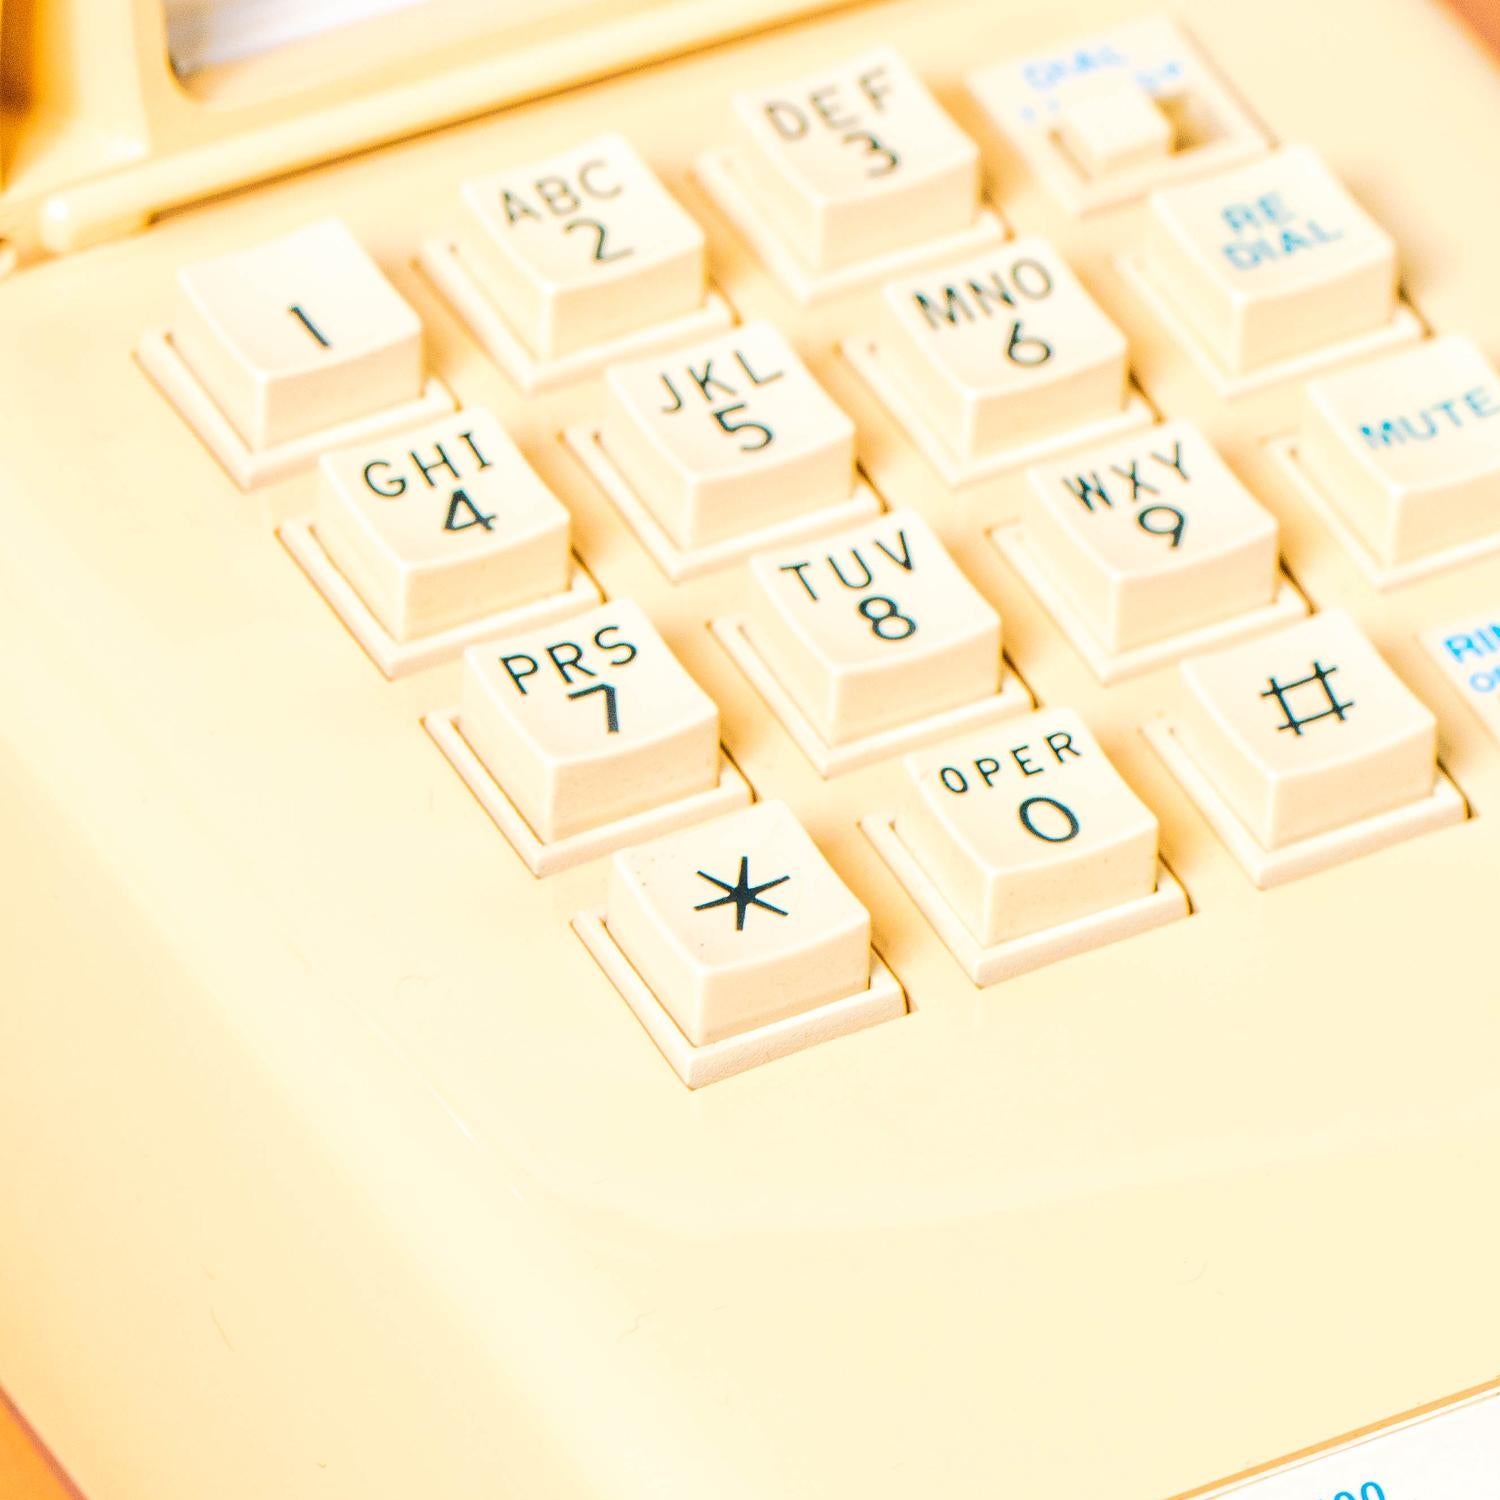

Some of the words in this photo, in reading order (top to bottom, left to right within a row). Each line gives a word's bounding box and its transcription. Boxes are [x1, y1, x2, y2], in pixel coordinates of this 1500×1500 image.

[762, 66, 893, 143] DEF
[842, 130, 903, 179] 3
[499, 159, 625, 227] ABC
[1219, 191, 1295, 235] RE
[564, 217, 635, 265] 2
[1219, 218, 1344, 272] DIAL
[913, 258, 1056, 329] MNO
[1006, 317, 1057, 366] 6
[659, 349, 785, 414] JKL
[712, 402, 776, 452] 5
[362, 430, 494, 498] GHI
[1061, 439, 1191, 515] WXY
[442, 488, 498, 533] 4
[1136, 502, 1187, 549] 9
[777, 528, 917, 602] TUV
[856, 595, 919, 641] 8
[498, 623, 640, 697] PRS
[567, 682, 621, 735] 7
[939, 729, 1084, 796] OPER
